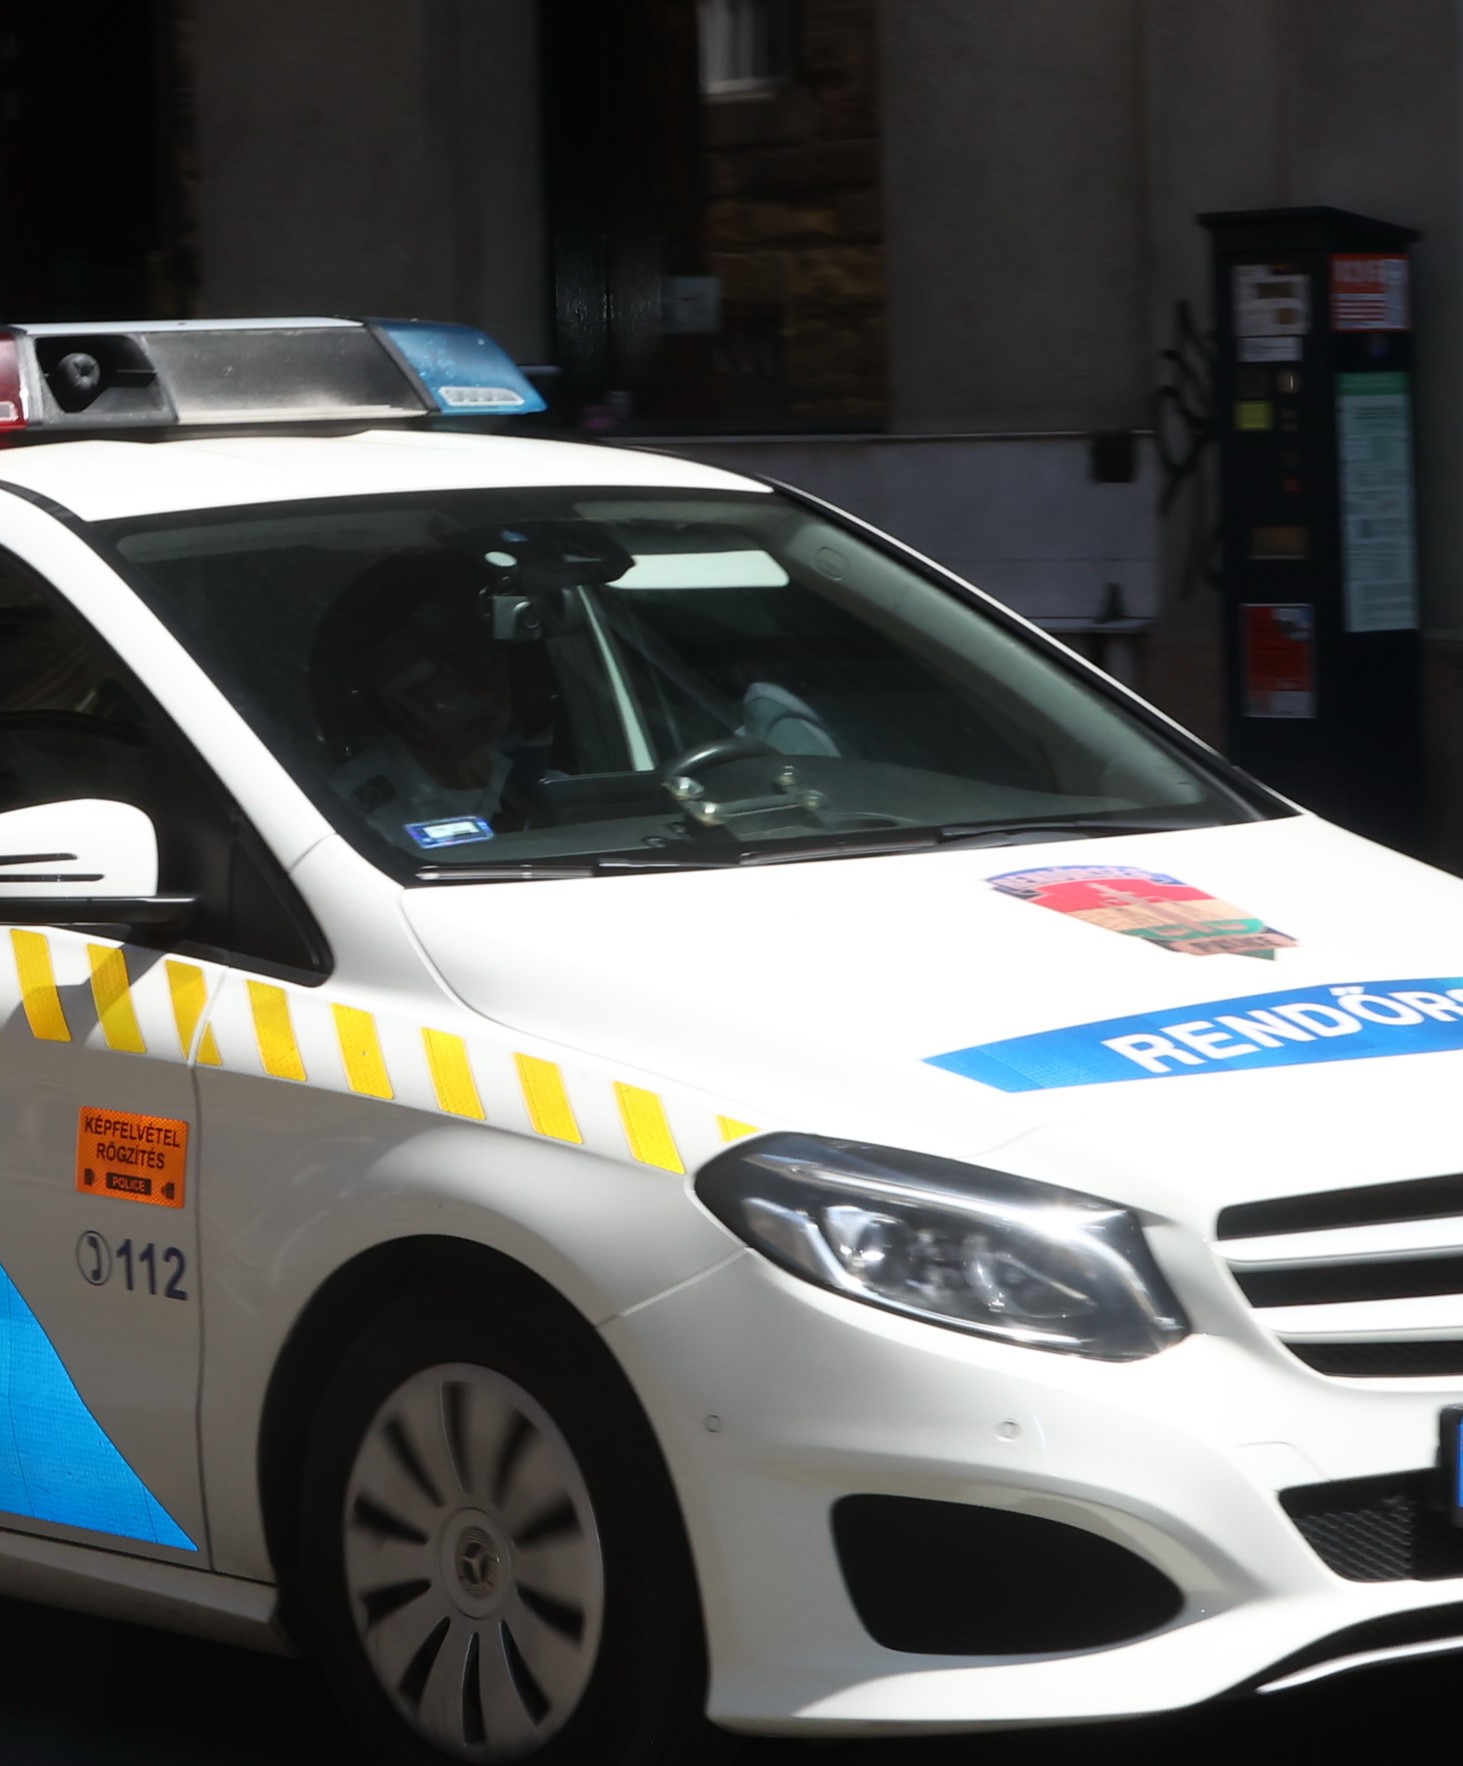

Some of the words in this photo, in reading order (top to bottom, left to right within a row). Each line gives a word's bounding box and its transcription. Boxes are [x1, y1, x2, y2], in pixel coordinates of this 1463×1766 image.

[85, 1114, 181, 1148] KÉPFELVÉTEL
[96, 1141, 166, 1170] RÖGZÍTÉS
[112, 1175, 146, 1192] POLICE
[116, 1238, 189, 1301] 112
